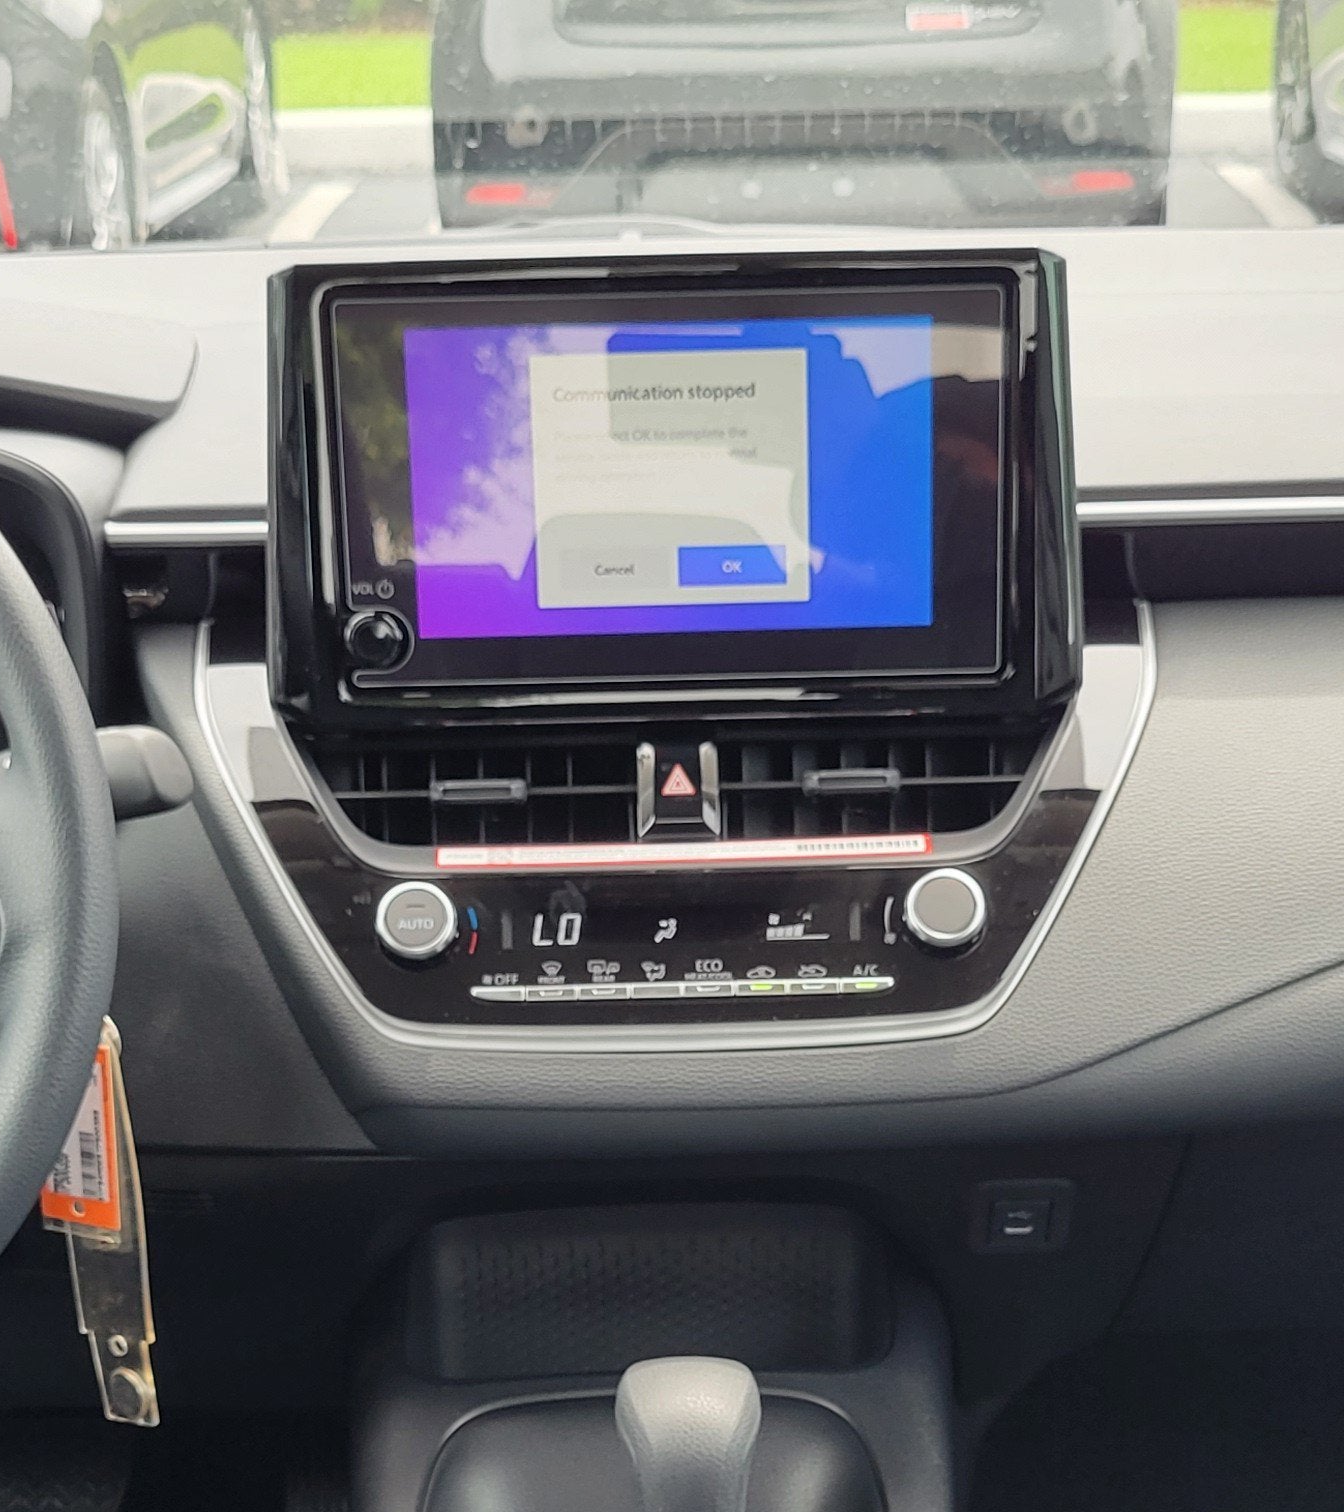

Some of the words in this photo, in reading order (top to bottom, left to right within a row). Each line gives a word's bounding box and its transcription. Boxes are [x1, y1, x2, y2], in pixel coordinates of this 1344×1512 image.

[552, 383, 683, 402] Communication
[688, 382, 756, 401] stopped
[594, 563, 635, 576] Cancel
[721, 560, 743, 573] OK
[398, 918, 434, 930] AUTO
[532, 912, 582, 946] LO
[695, 959, 724, 973] ECO
[853, 964, 879, 976] A/C
[494, 973, 519, 985] OFF
